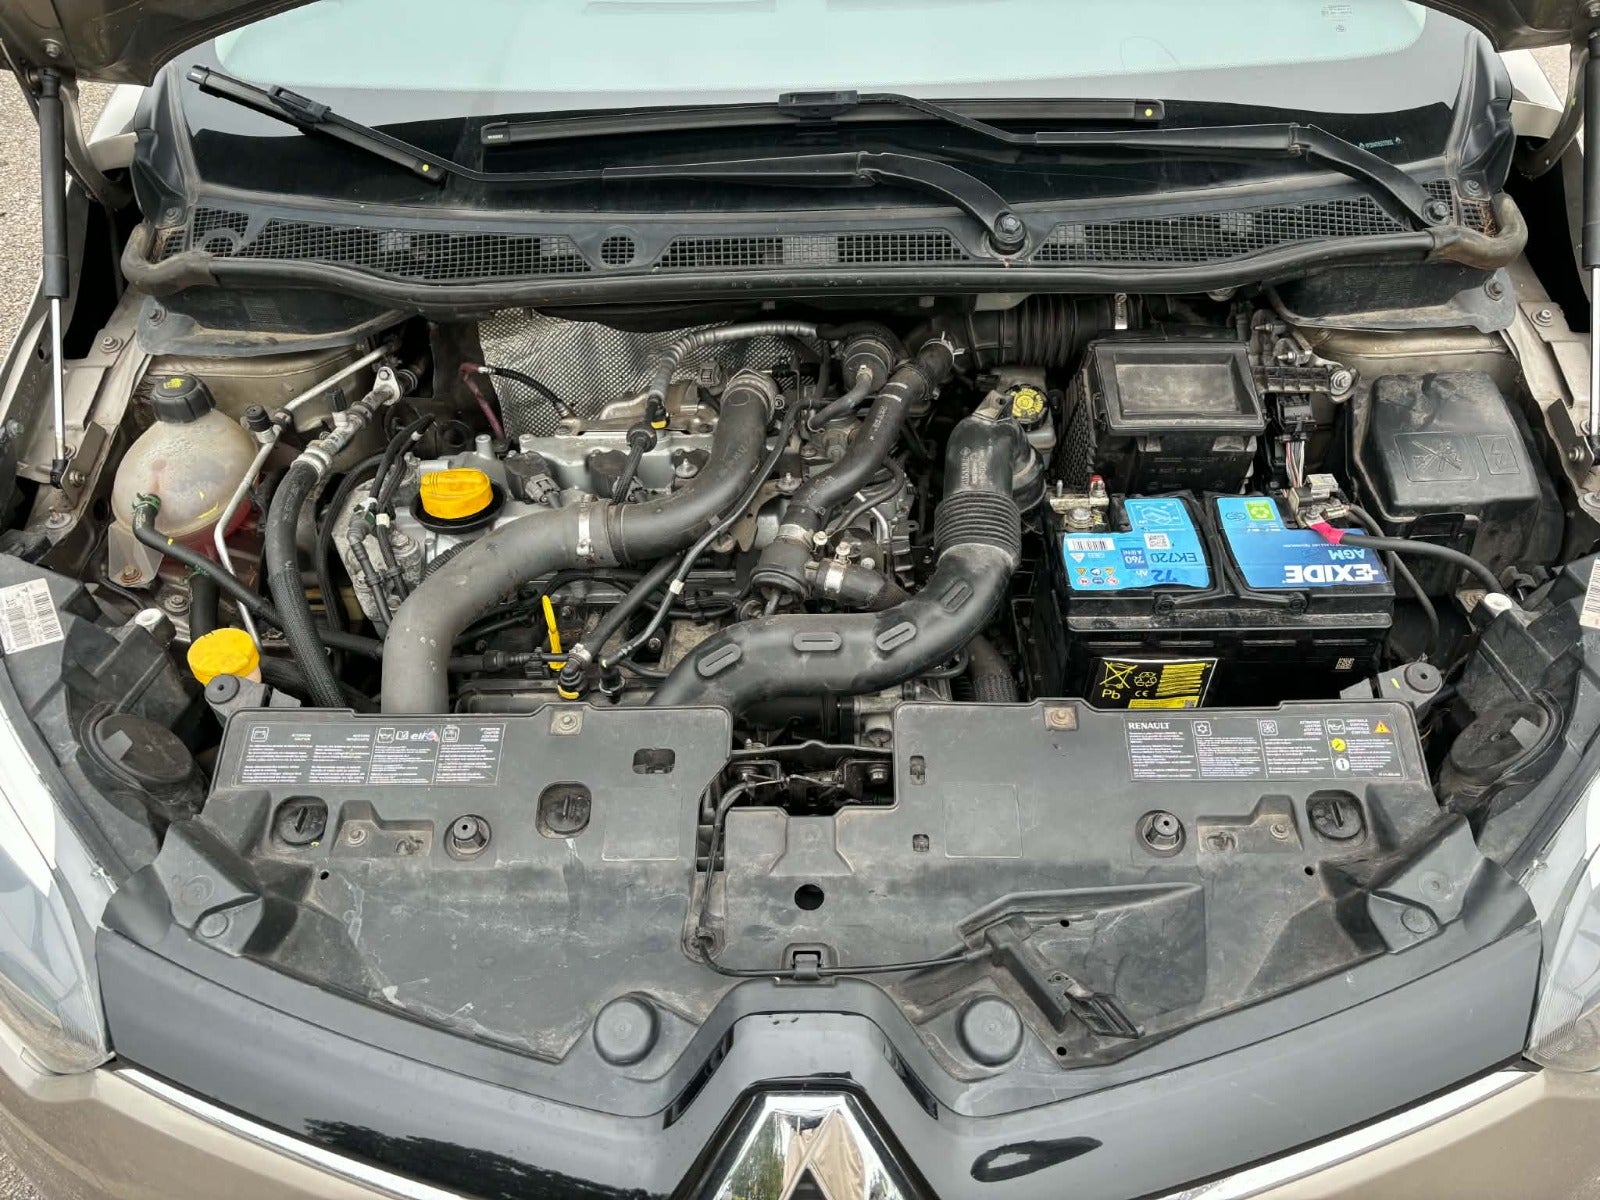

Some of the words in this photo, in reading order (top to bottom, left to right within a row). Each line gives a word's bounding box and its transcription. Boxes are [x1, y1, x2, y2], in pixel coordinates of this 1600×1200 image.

[1124, 556, 1144, 564] 760
[1151, 552, 1197, 563] EK720
[1328, 549, 1365, 561] AGM
[1151, 569, 1179, 583] 72
[1284, 564, 1378, 583] EXIDE
[1101, 689, 1121, 699] Pb
[1128, 722, 1170, 730] RENAULT
[410, 730, 426, 740] elf
